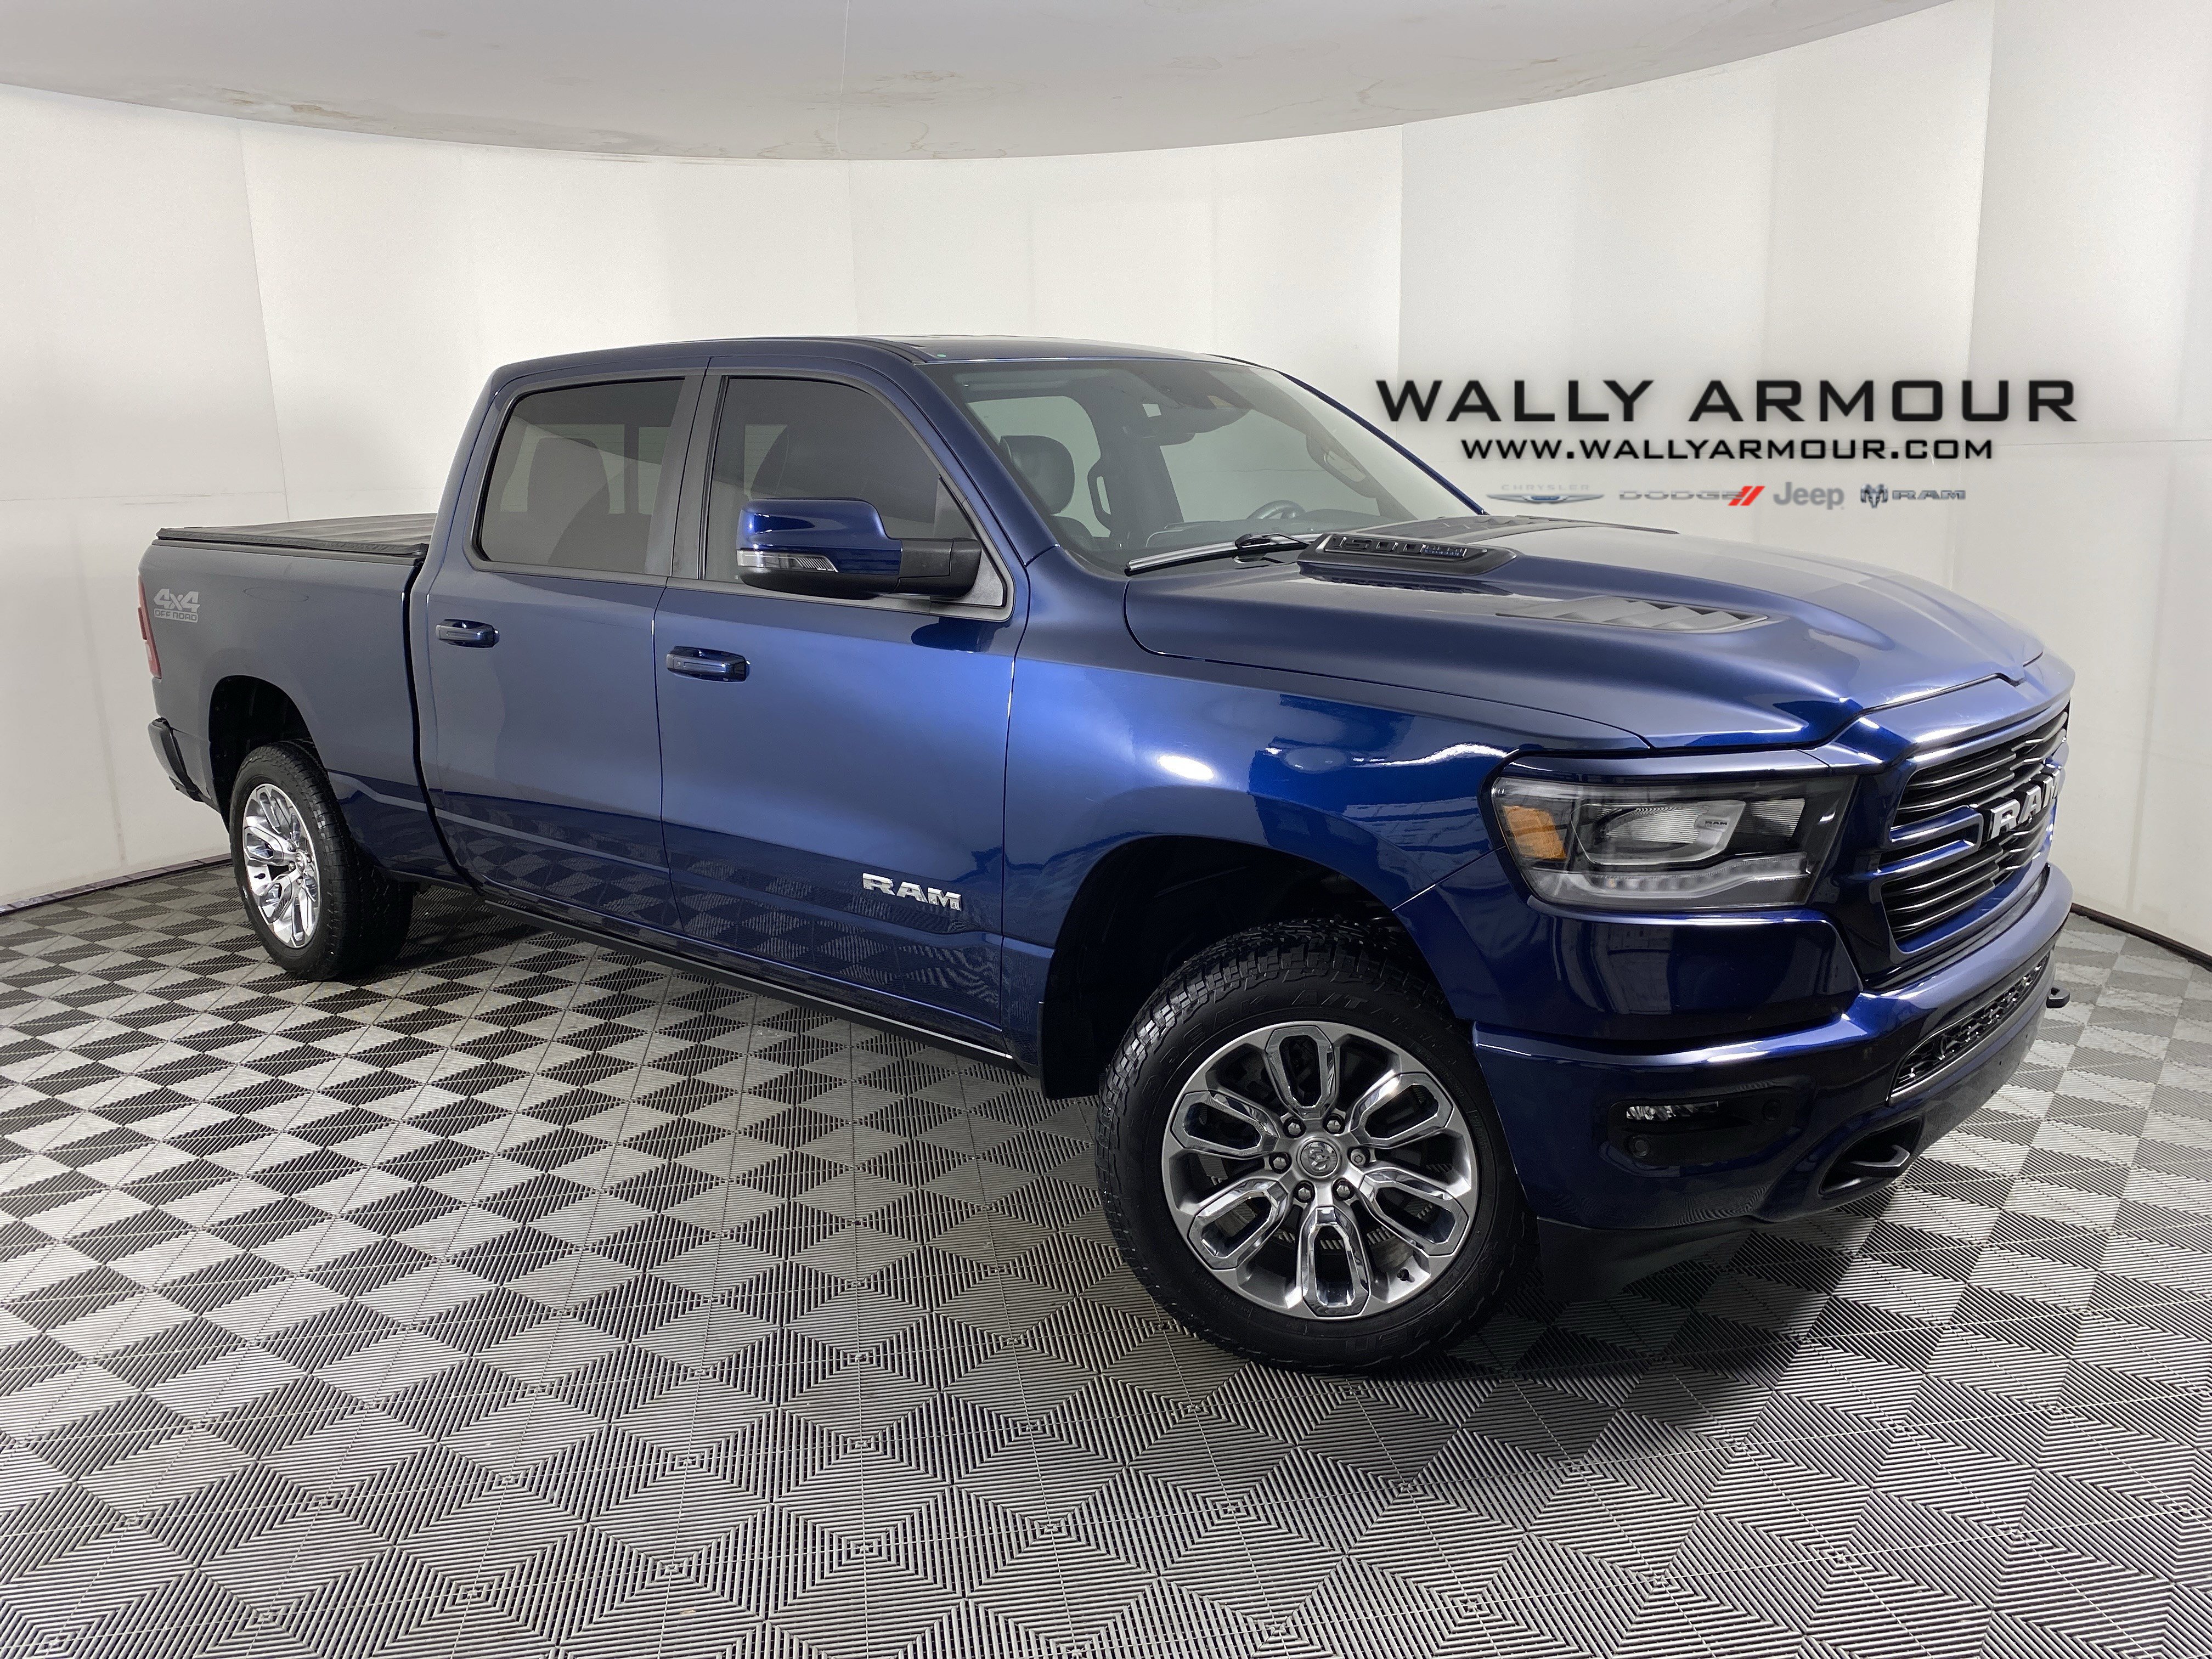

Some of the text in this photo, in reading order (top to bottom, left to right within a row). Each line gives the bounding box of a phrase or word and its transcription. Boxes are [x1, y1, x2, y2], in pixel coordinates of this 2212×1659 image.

[155, 610, 198, 621] OFF ROAD
[1987, 769, 2061, 842] RAM
[862, 872, 962, 912] RAM
